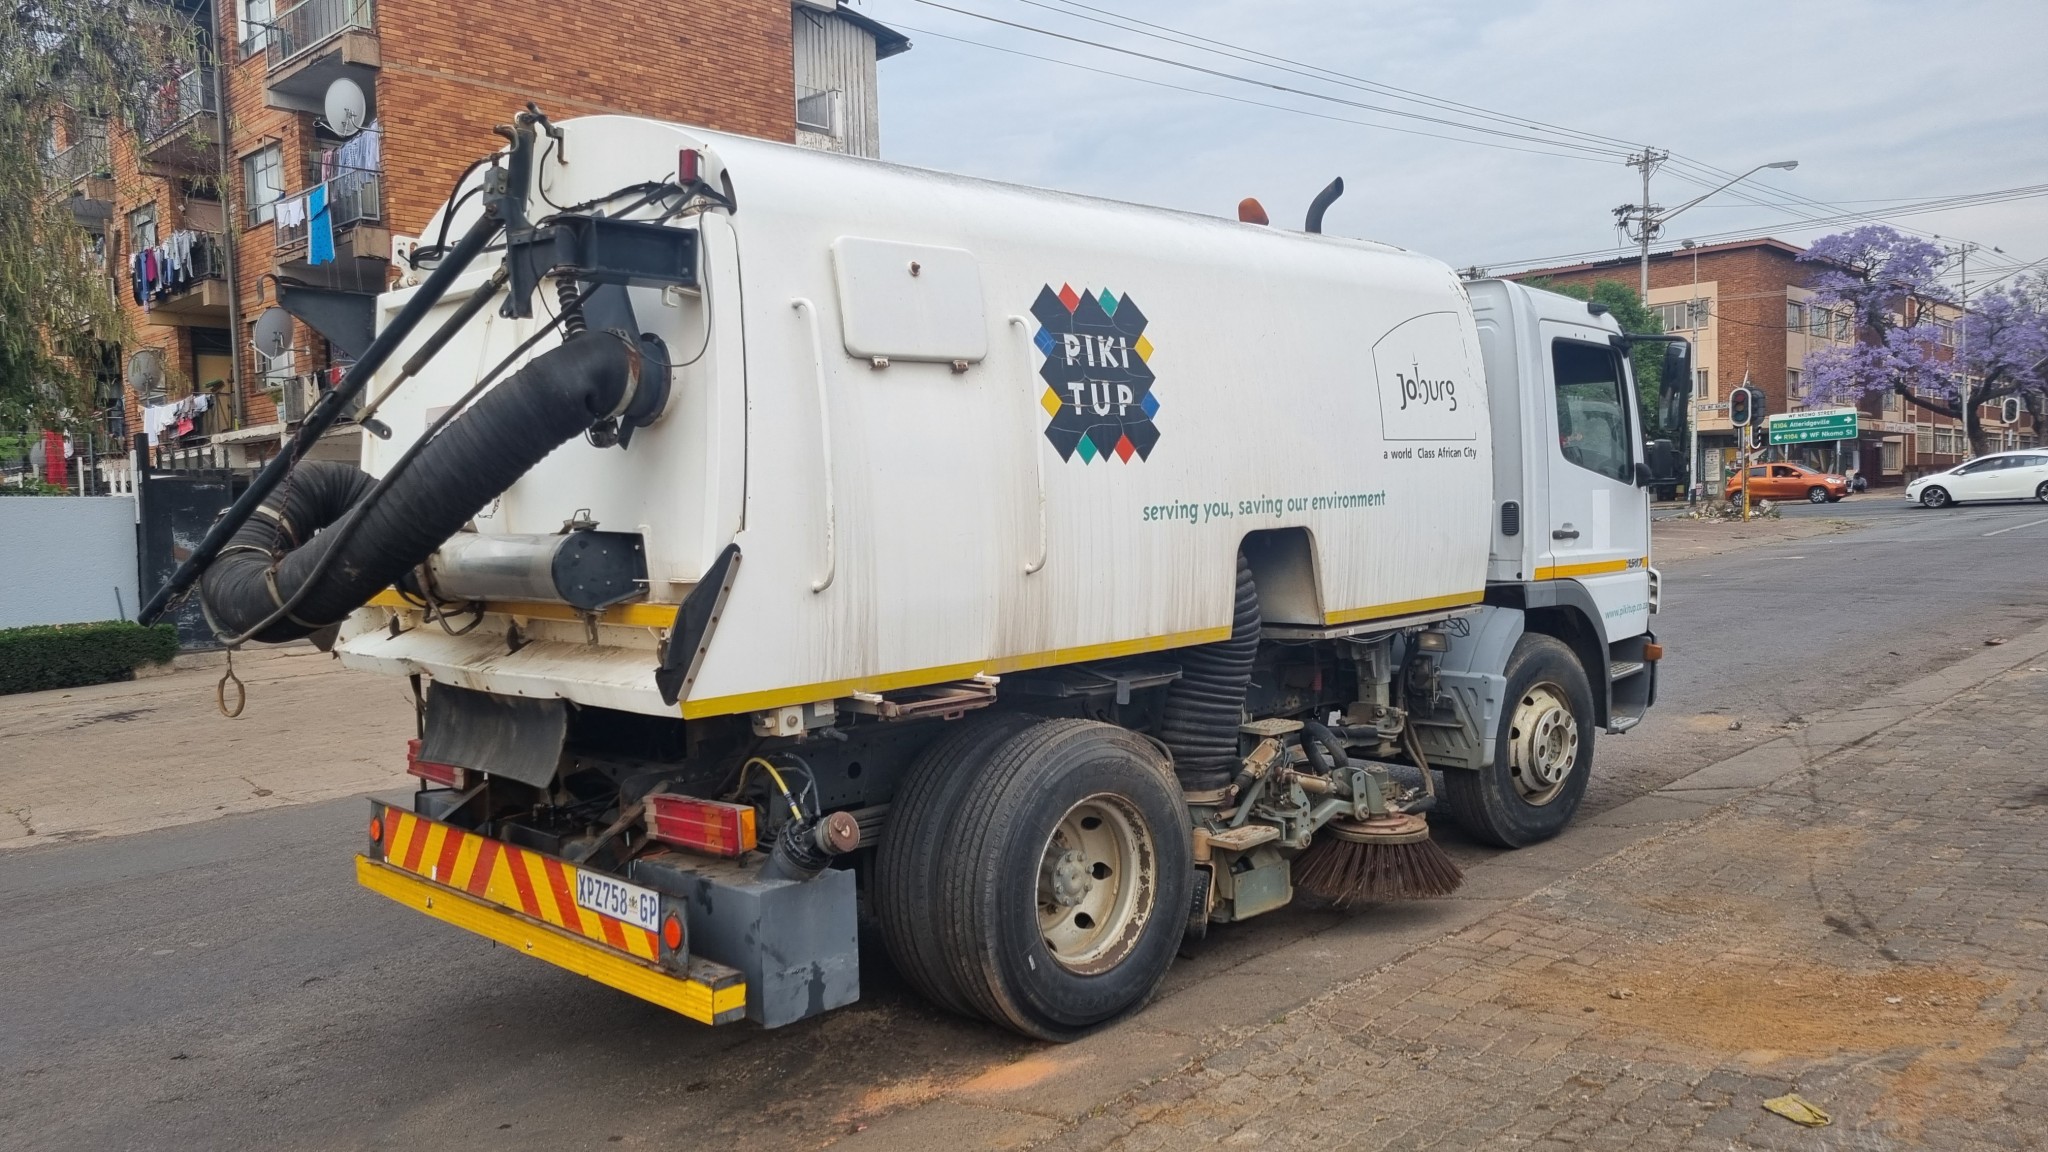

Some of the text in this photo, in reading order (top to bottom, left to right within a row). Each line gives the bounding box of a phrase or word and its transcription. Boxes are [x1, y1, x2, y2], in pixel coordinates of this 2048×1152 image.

[1063, 333, 1129, 368] PIKI
[1067, 381, 1133, 416] TUP
[1396, 358, 1457, 411] Joburg
[1789, 420, 1830, 428] Atteridgeville
[1383, 447, 1477, 459] a world Class African City
[1143, 490, 1386, 524] serving you, saving our environment
[578, 874, 657, 925] XPZ758 GP
